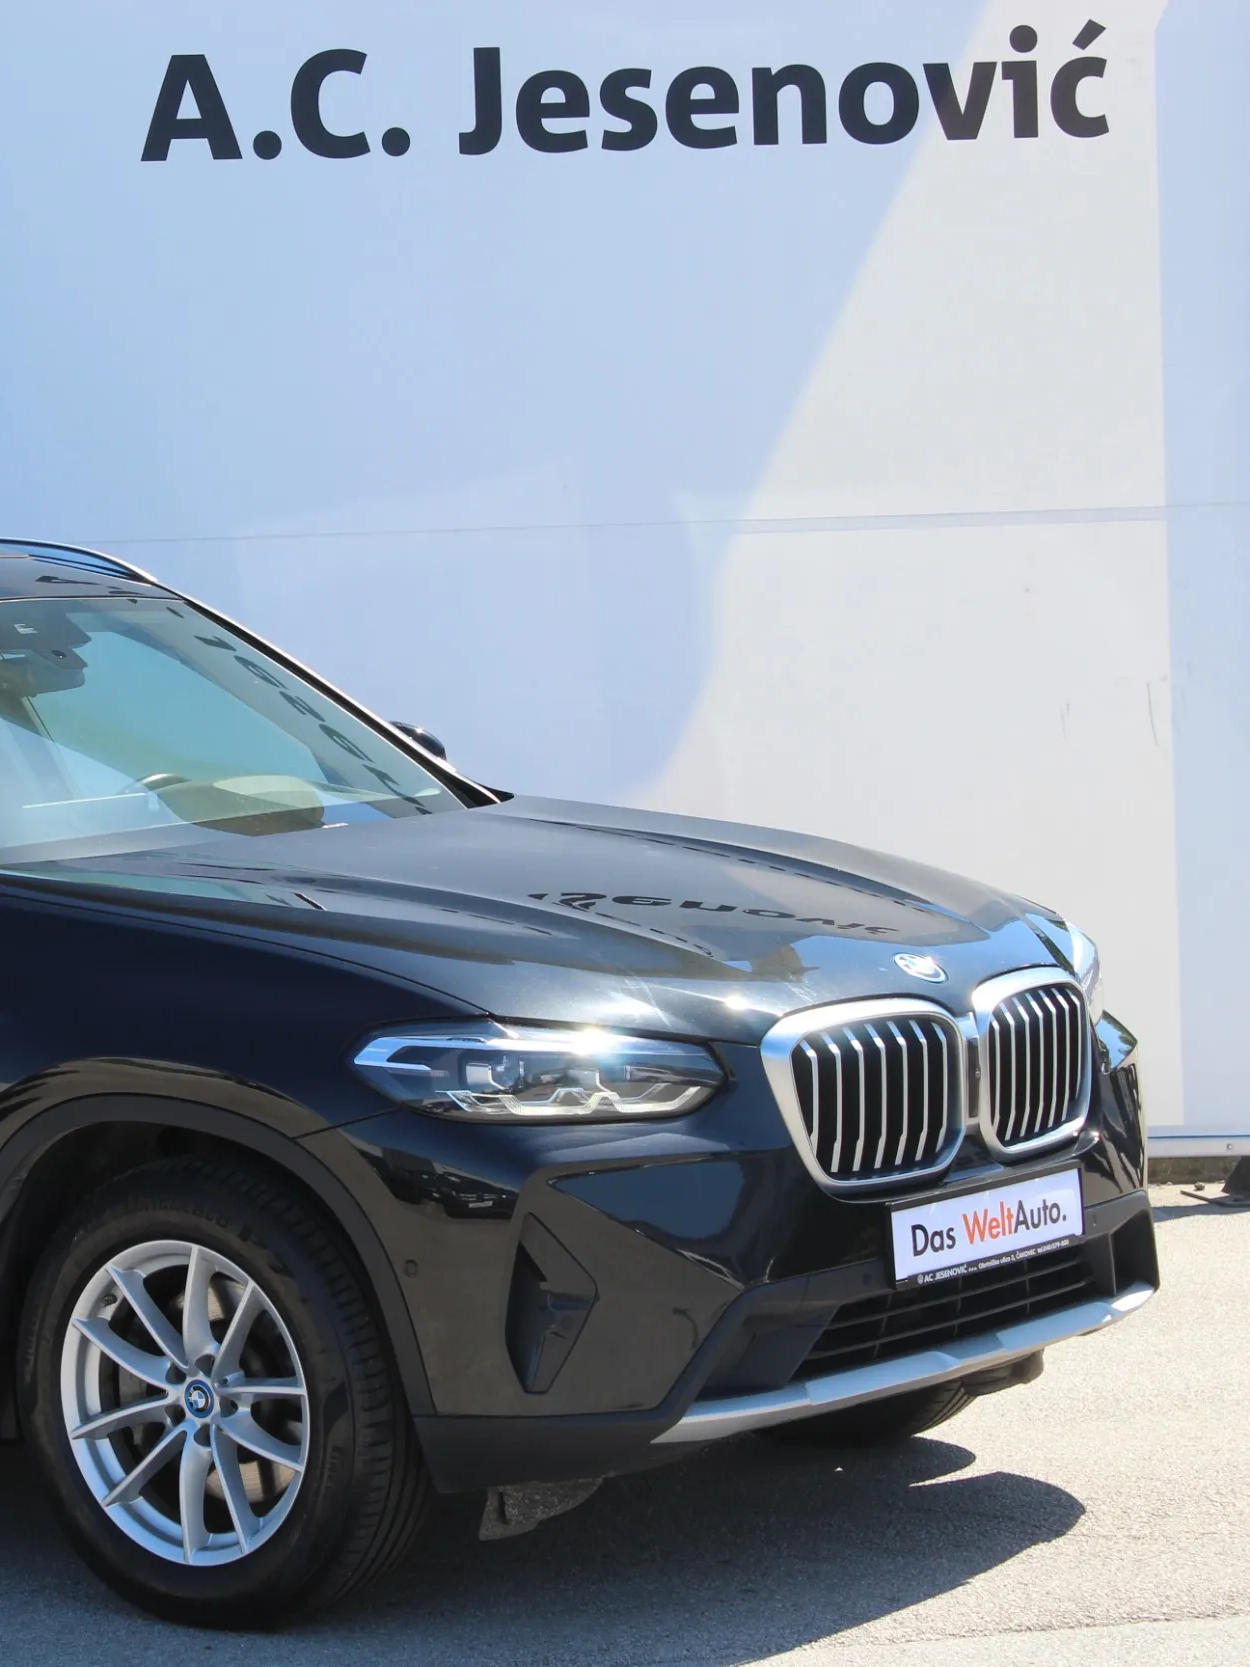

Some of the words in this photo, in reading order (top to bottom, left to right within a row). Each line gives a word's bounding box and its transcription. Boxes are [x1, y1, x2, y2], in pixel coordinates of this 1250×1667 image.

[141, 49, 410, 161] A.C.
[459, 20, 1109, 155] Jesenović
[911, 1224, 956, 1257] Das
[962, 1199, 1067, 1245] WeltAuto.
[924, 1273, 933, 1283] AC
